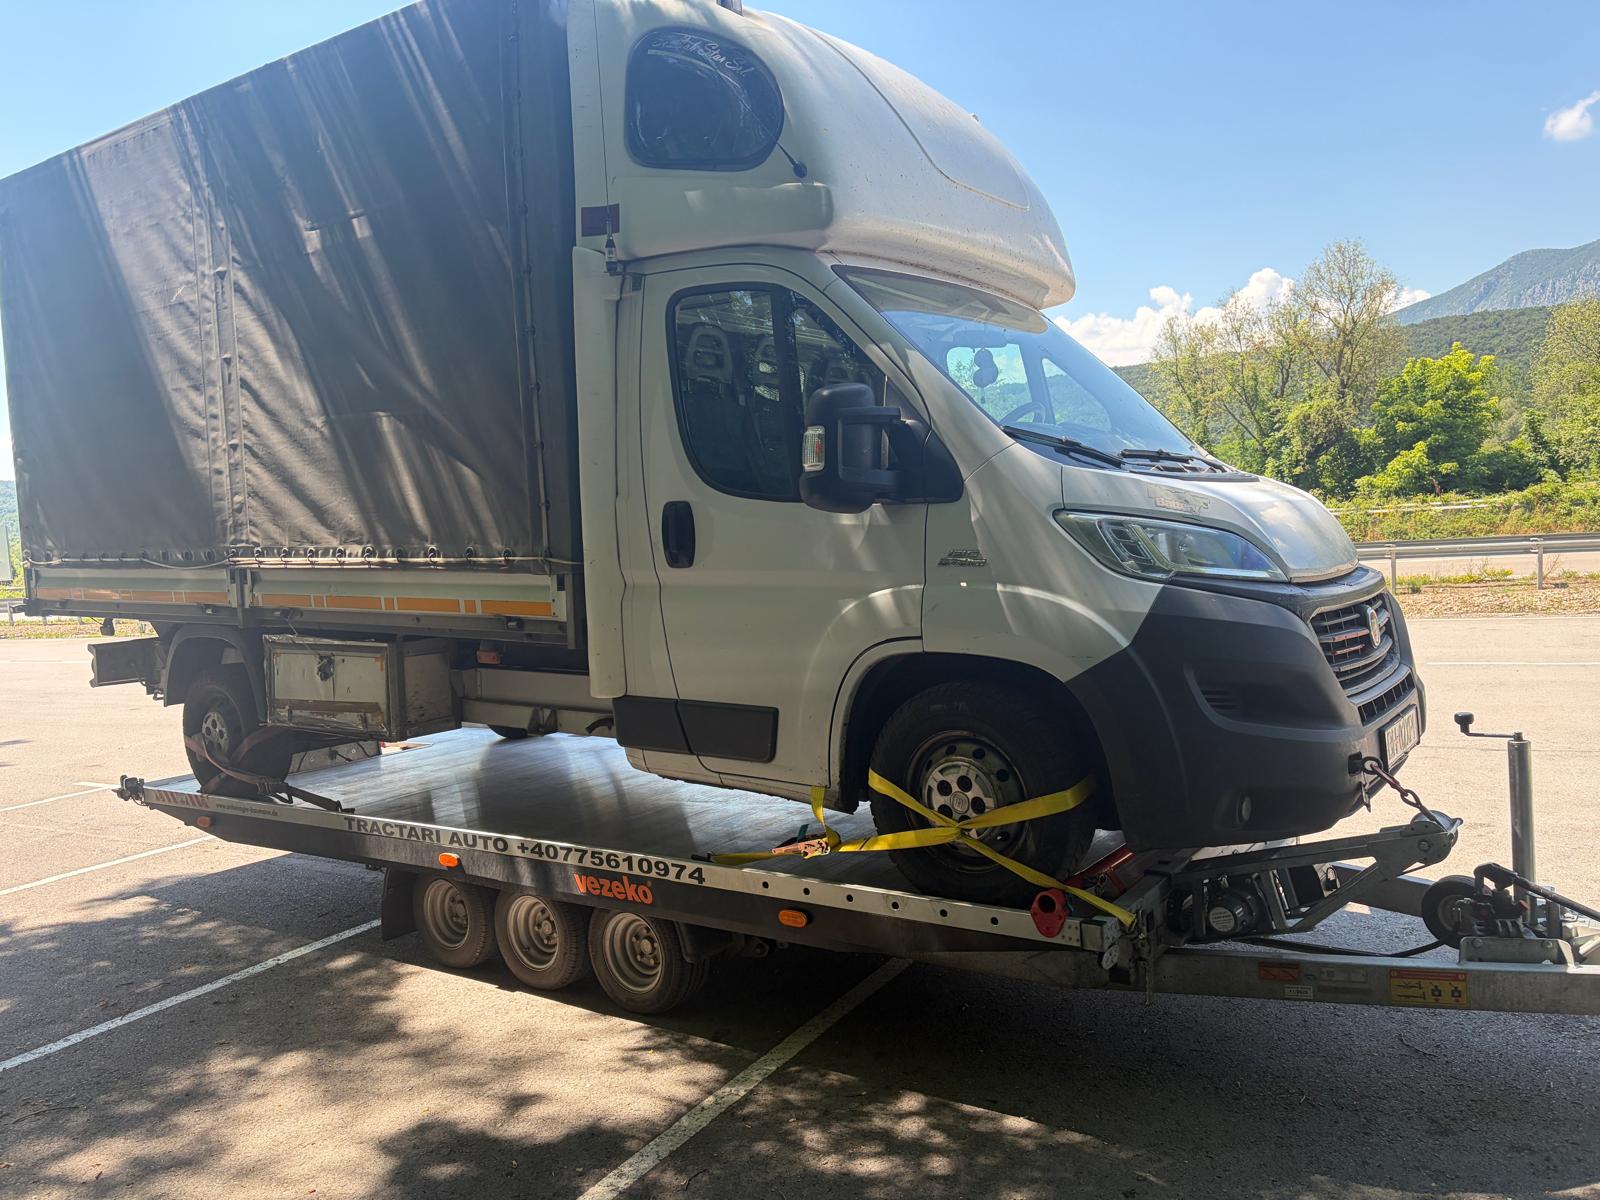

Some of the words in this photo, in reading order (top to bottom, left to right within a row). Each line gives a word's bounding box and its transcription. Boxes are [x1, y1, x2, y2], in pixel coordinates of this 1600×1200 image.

[343, 816, 442, 844] TRACTARI
[448, 830, 509, 853] AUTO
[517, 841, 706, 885] +40775610974
[573, 873, 653, 905] vezeko
